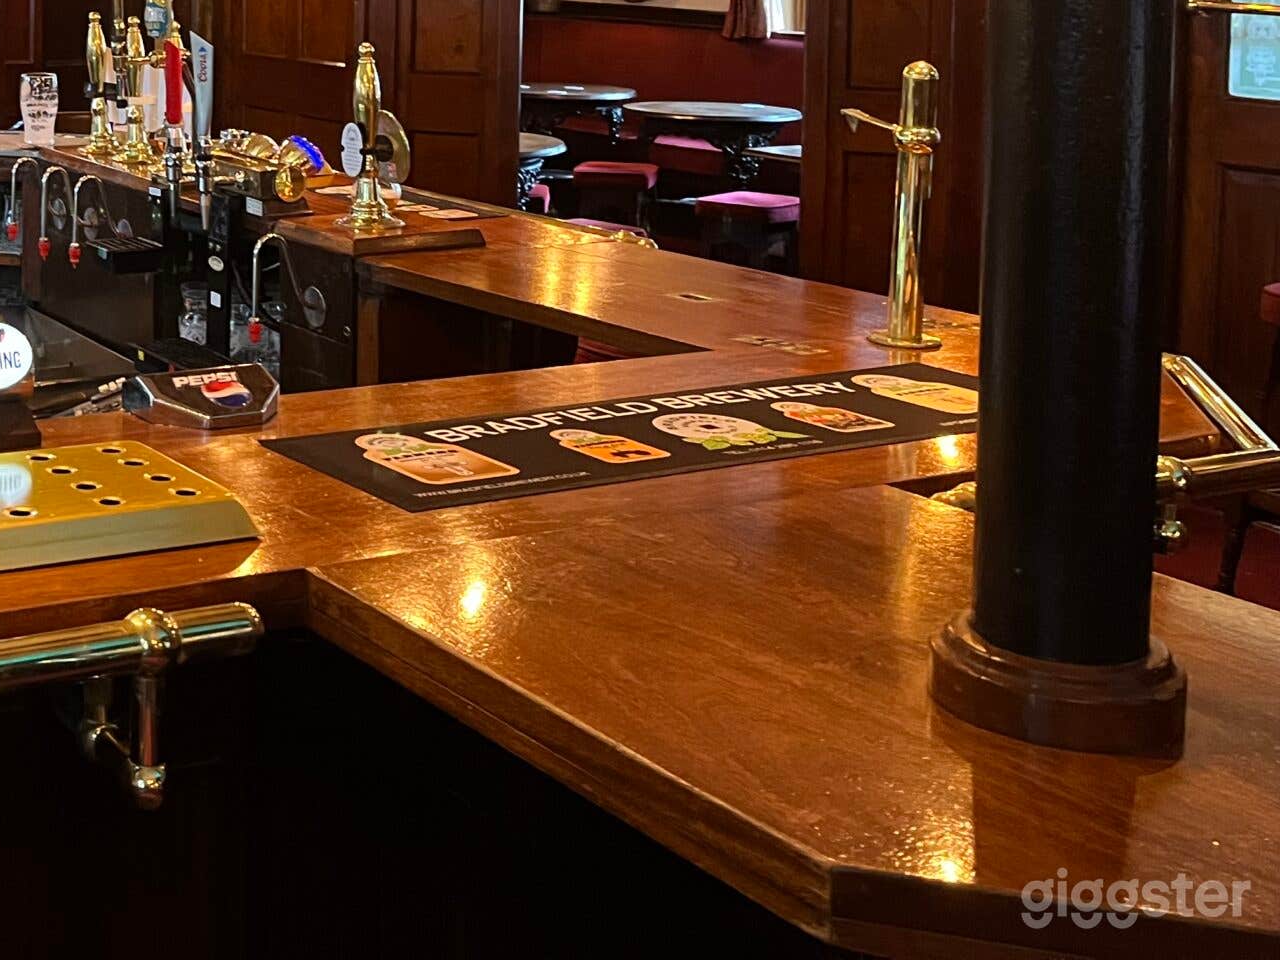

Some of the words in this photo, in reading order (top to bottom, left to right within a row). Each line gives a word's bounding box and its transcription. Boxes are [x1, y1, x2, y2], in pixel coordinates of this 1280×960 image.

[171, 371, 238, 388] PEPSI
[422, 401, 659, 443] BRADFIELD
[658, 380, 857, 410] BREWERY
